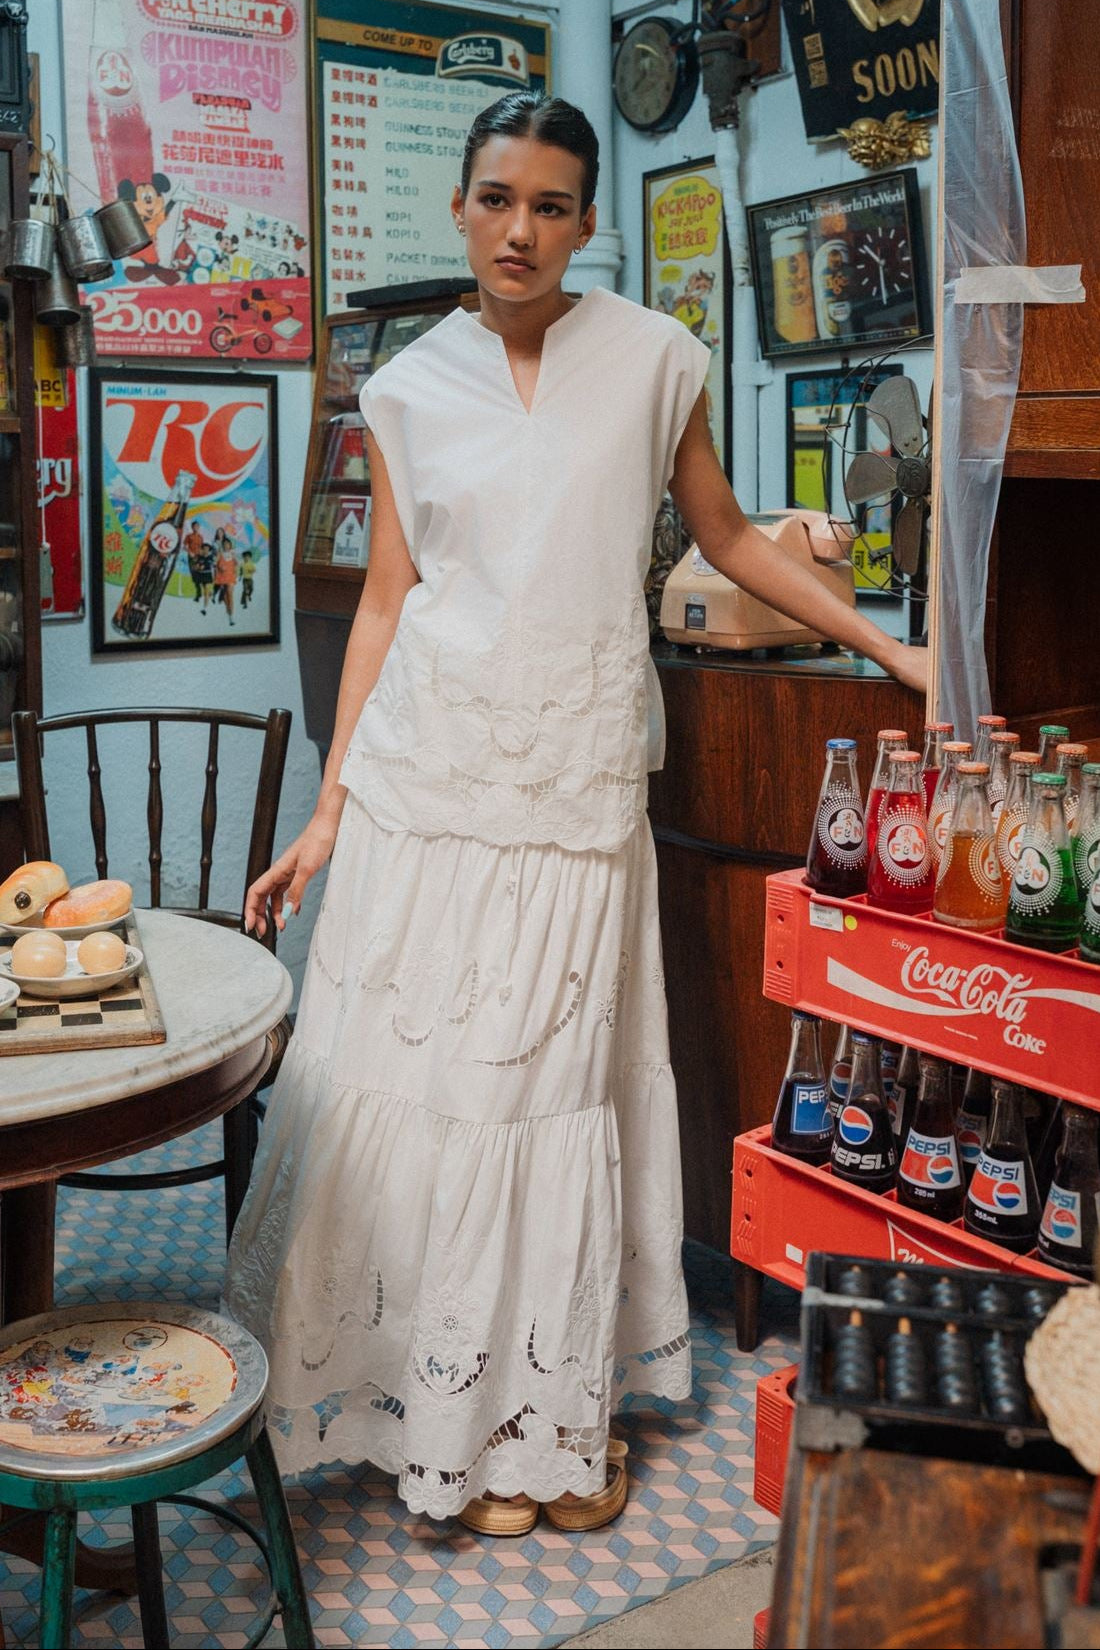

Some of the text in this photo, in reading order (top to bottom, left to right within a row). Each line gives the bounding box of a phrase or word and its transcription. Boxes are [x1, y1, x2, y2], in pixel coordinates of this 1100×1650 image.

[363, 30, 433, 51] COME UP TO
[447, 39, 496, 64] Carlsberg
[852, 40, 939, 103] SOON
[159, 63, 282, 113] Disney
[384, 77, 446, 94] CARLSBERG
[384, 121, 468, 139] GUINNESS STOUT
[385, 141, 464, 157] GUINNESS STOU
[386, 167, 409, 178] MILO
[332, 204, 357, 217] 咖啡
[800, 208, 816, 222] The
[815, 205, 832, 218] Best
[831, 201, 852, 216] Beer
[853, 198, 863, 211] In
[862, 194, 879, 209] The
[879, 187, 905, 204] World
[386, 211, 412, 222] KOPI
[386, 229, 420, 240] KOPI O
[386, 252, 467, 268] PACKET DRINKS
[86, 291, 202, 336] 25,000
[105, 399, 264, 498] RC
[891, 938, 911, 952] Enjoy
[901, 946, 1033, 1024] Coca-Cola
[1003, 1025, 1047, 1055] Coke
[908, 1135, 951, 1155] PEPSI
[978, 1156, 1019, 1181] PEPSI
